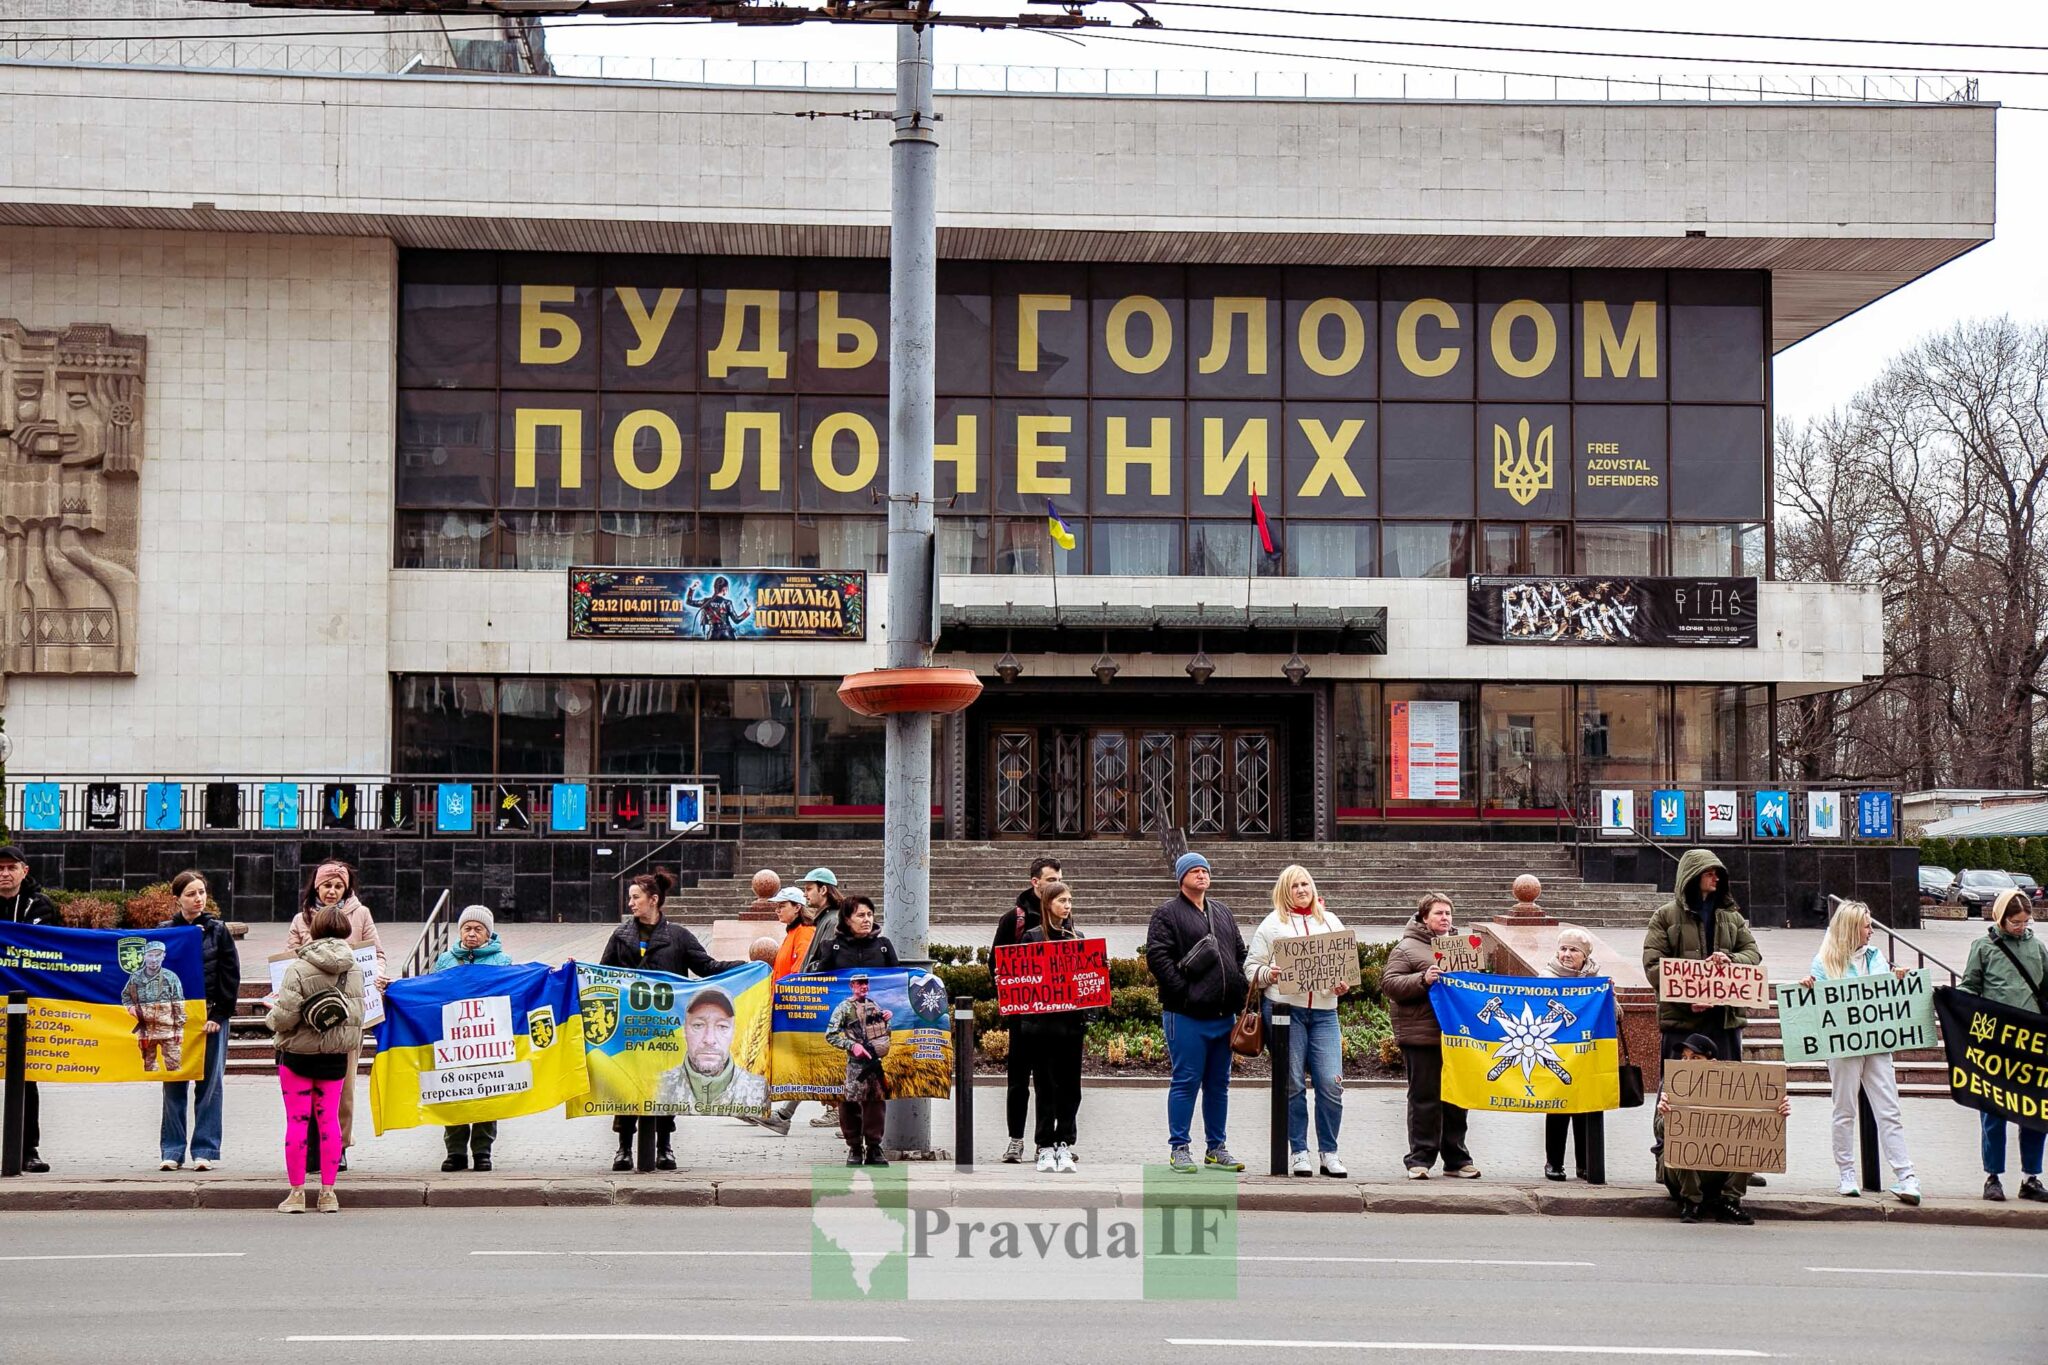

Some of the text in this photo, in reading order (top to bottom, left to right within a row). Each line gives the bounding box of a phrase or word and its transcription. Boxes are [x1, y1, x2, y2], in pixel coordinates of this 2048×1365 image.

[520, 285, 1657, 379] БУДЬ ГОЛОСОМ
[515, 408, 1366, 497] ПОЛОНЕНИХ
[1587, 443, 1619, 454] FREE
[1587, 459, 1650, 470] AZOVSTAL
[1587, 475, 1659, 487] DEFENDERS
[755, 610, 843, 629] ПОЛТАВКА
[6, 946, 63, 959] Кузьмин
[1284, 937, 1356, 957] КОЖЕН ДЕНЬ
[1433, 938, 1463, 949] ЧЕКАЮ
[22, 958, 102, 973] Васильович
[1000, 959, 1043, 977] ДЕНЬ
[1294, 953, 1346, 971] ПОЛОНУ
[1438, 953, 1478, 972] СИНУ
[1663, 959, 1764, 982] БАЙДУЖІСТЬ
[1280, 972, 1294, 982] ЦЕ
[1299, 964, 1346, 980] ВТРАЧЕНІ
[775, 984, 828, 995] Григорович
[1010, 985, 1072, 1004] ПОЛОНІ
[1781, 972, 1923, 1008] ТИ ВІЛЬНИЙ
[40, 1007, 91, 1020] безвісти
[458, 1000, 485, 1023] ДЕ
[1001, 1004, 1029, 1014] ВОЛЮ
[1032, 1002, 1047, 1012] 12
[1822, 1001, 1911, 1029] А ВОНИ
[451, 1017, 495, 1040] наші
[49, 1035, 98, 1048] бригада
[1803, 1025, 1924, 1055] В ПОЛОНІ
[2001, 1024, 2048, 1055] FRE
[437, 1040, 515, 1063] ХЛОПЦІ?
[56, 1062, 100, 1075] району
[1966, 1046, 2048, 1088] AZOVST
[441, 1070, 505, 1084] 68 окрема
[1671, 1069, 1779, 1101] СИГНАЛЬ
[422, 1080, 528, 1101] єгерська бригада
[584, 1100, 640, 1113] Олійник
[643, 1100, 691, 1113] Віталій
[1489, 1096, 1568, 1109] ЕДЕЛЬВЕЙС
[1668, 1109, 1684, 1137] В
[1669, 1140, 1784, 1169] ПОЛОНЕНИХ
